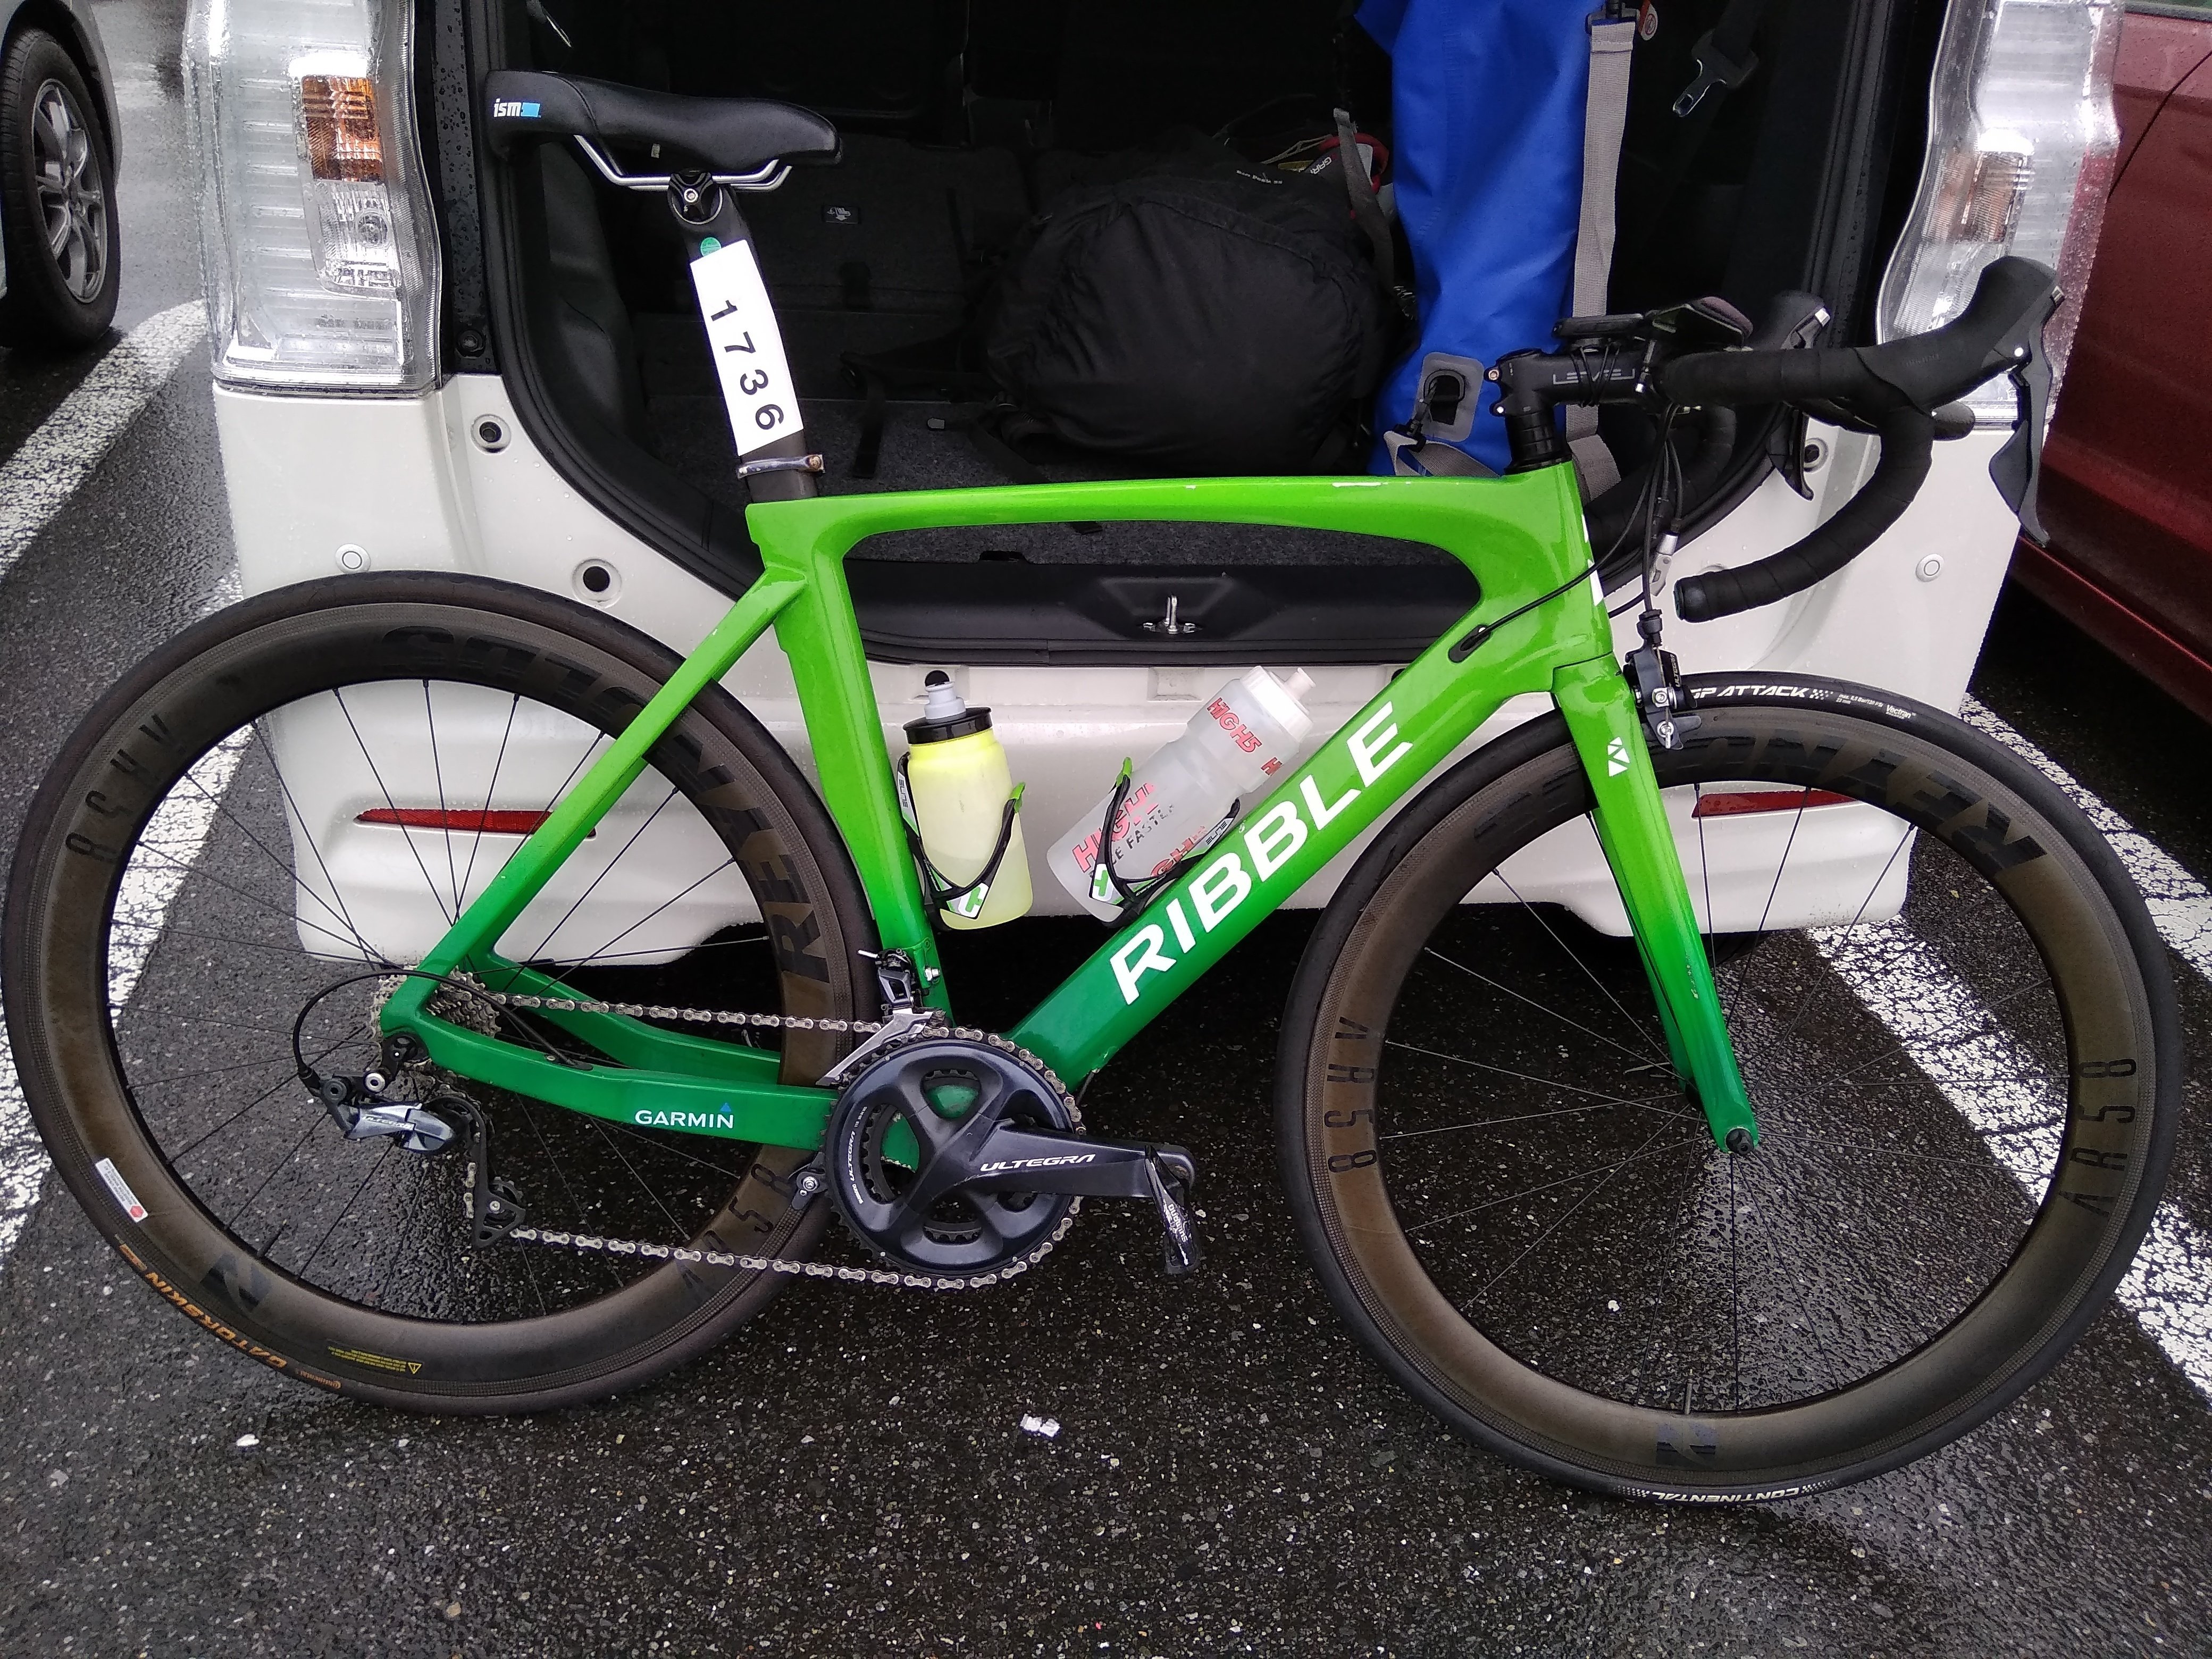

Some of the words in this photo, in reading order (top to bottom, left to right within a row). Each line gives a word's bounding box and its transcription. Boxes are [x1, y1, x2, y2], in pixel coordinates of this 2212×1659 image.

[493, 98, 521, 117] ism
[710, 300, 784, 430] 1736
[1670, 654, 1680, 688] ULTEGRA
[1717, 685, 1808, 699] ATTACK
[1886, 705, 1912, 718] Vectran
[1208, 697, 1262, 752] HIGH5
[1110, 701, 1412, 1005] RIBBLE
[361, 1116, 414, 1130] ULTEGRA
[635, 1110, 734, 1129] GARMIN
[981, 1153, 1095, 1172] ULTEGRA
[1167, 1203, 1188, 1242] SHIMANO
[1652, 1487, 1799, 1502] CONTINENTAL
